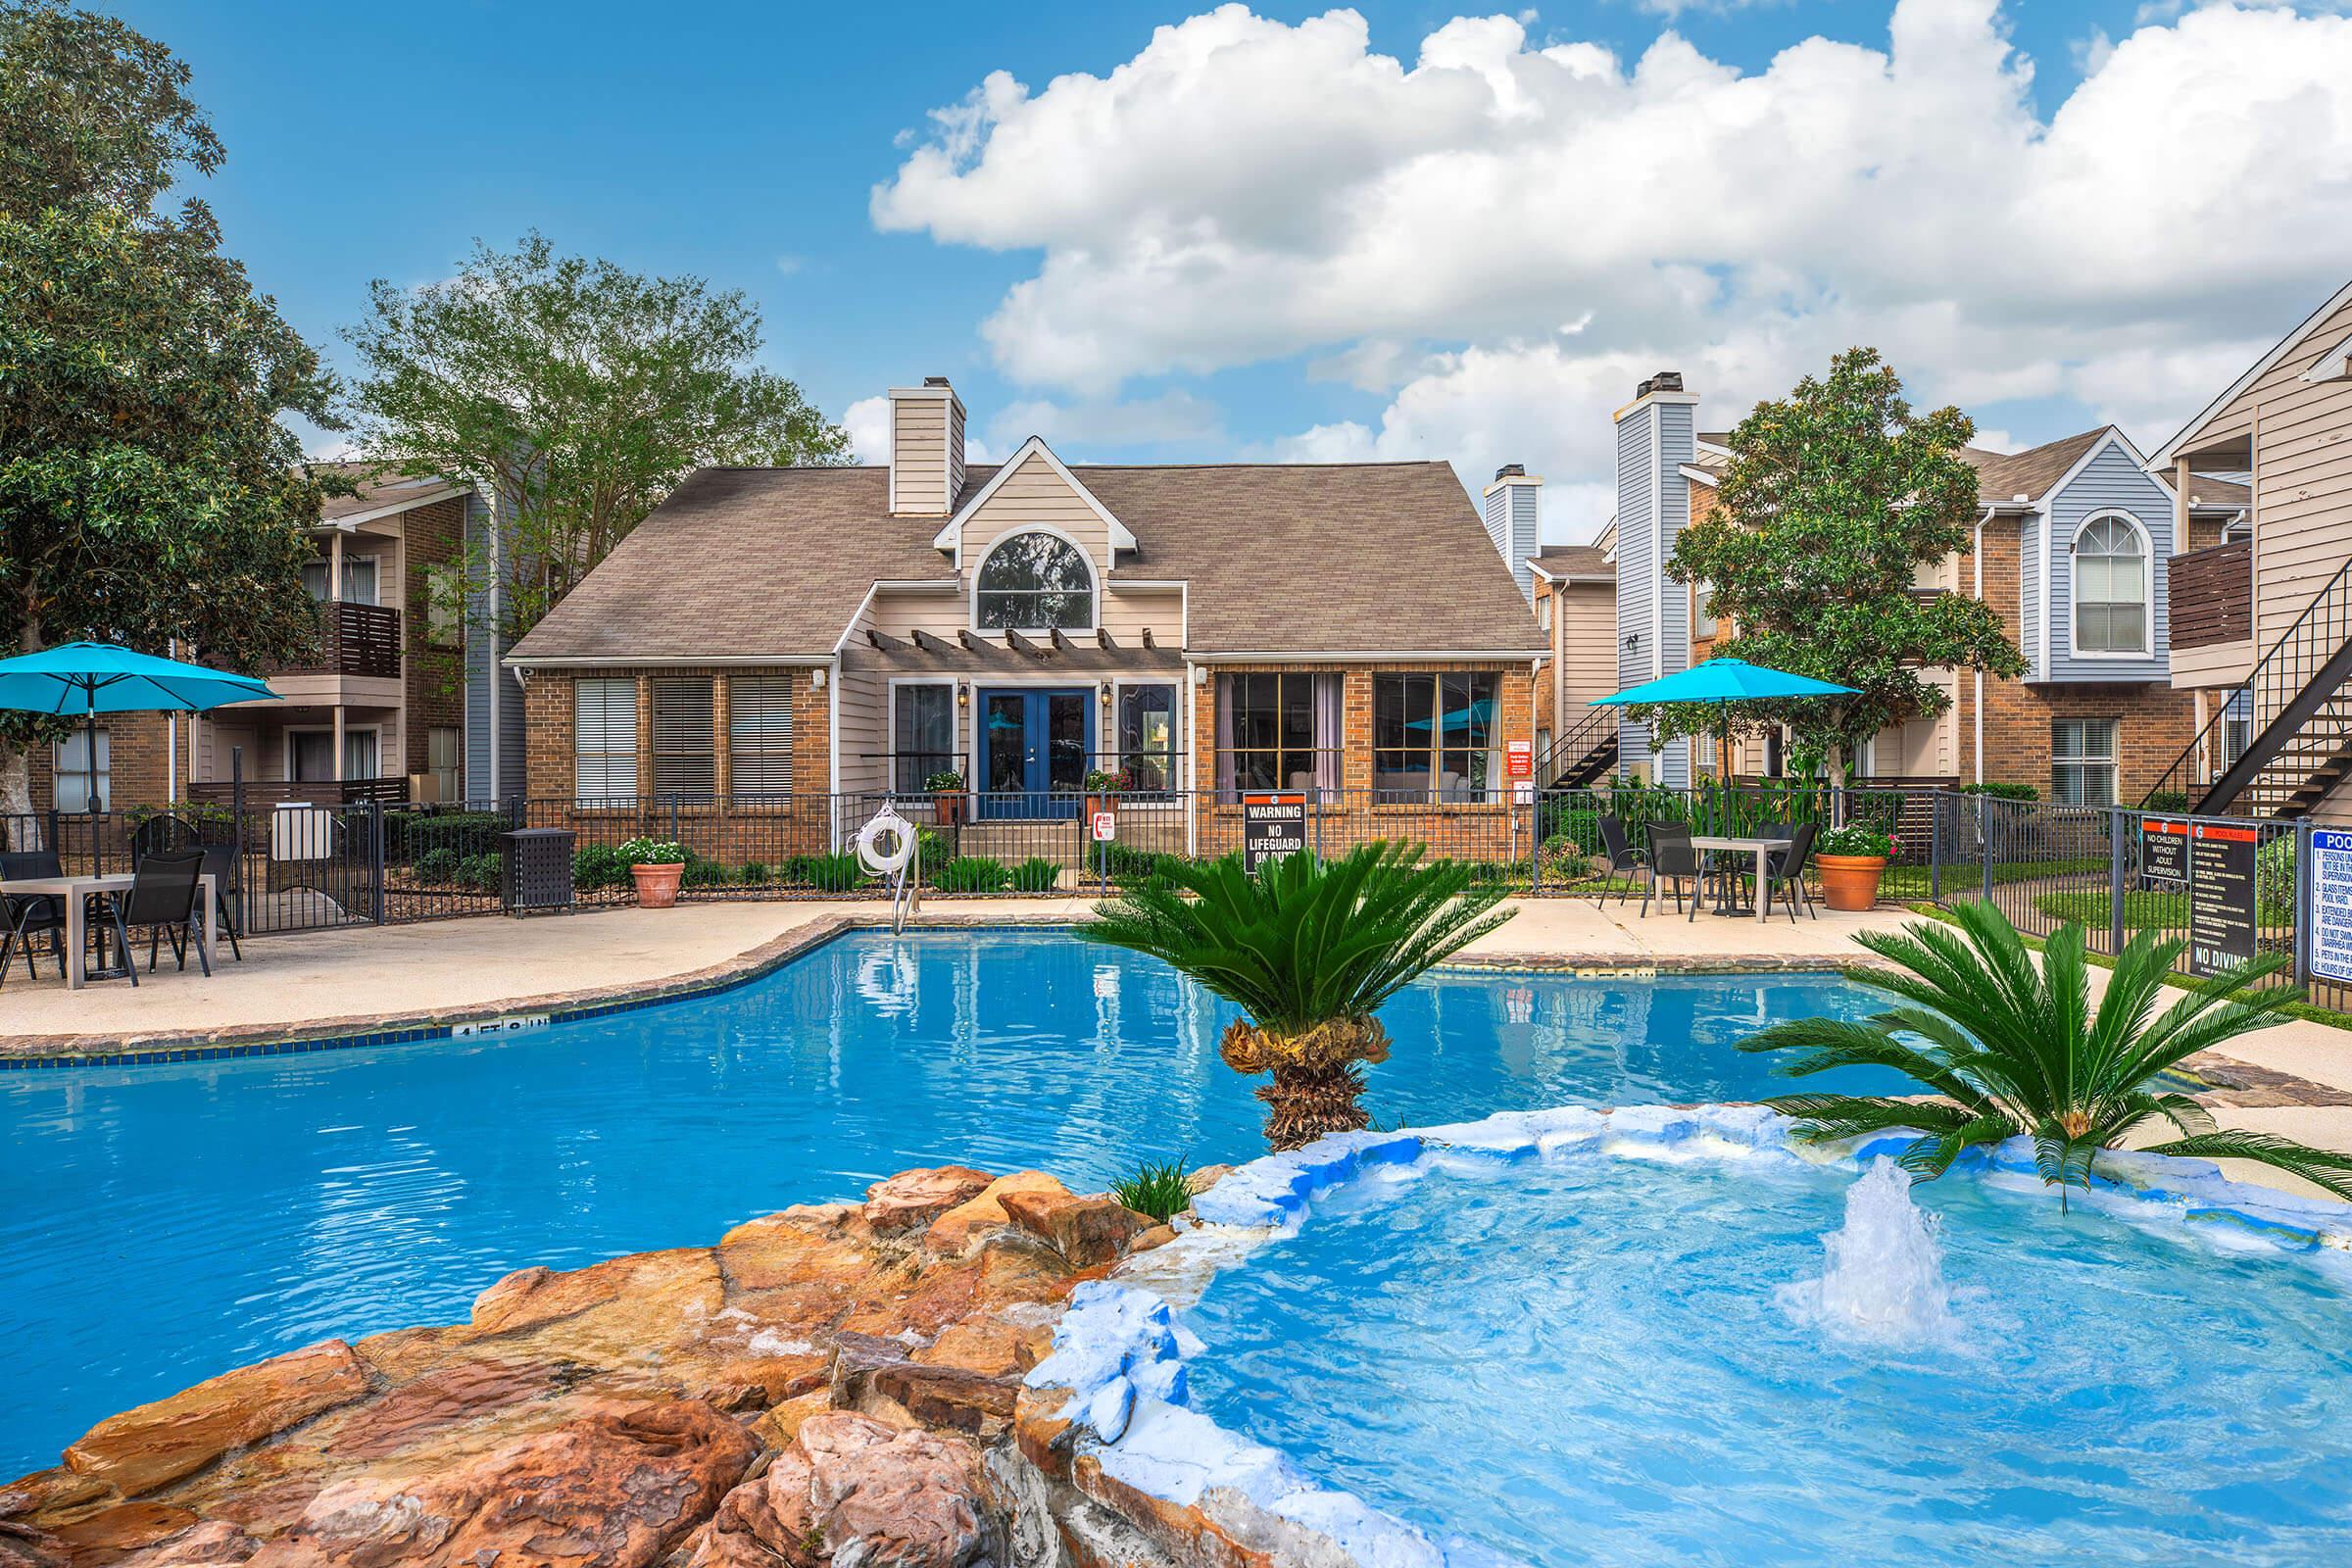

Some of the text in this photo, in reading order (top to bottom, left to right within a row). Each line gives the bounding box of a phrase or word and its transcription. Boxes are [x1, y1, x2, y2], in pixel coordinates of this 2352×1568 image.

[1250, 806, 1301, 818] WARNING
[1268, 825, 1282, 837] NO
[1250, 838, 1301, 850] LIFEGUARD
[2147, 834, 2182, 846] NO CHILDREN
[2327, 834, 2352, 850] POO
[2152, 845, 2178, 856] WITHOUT
[2323, 851, 2345, 862] PERSONS
[2155, 856, 2173, 865] ADULT
[2323, 860, 2332, 870] NOT
[2332, 861, 2339, 871] BE
[2147, 864, 2181, 877] SUPERVISION
[2323, 883, 2337, 894] GLASS
[2322, 893, 2334, 903] POOL
[2322, 905, 2347, 917] EXTENDED
[2322, 915, 2331, 925] ARE
[2322, 927, 2328, 937] DO
[2329, 929, 2339, 939] NOT
[2322, 937, 2345, 951] DIARRHEA
[2195, 946, 2210, 964] NO
[2322, 950, 2333, 960] PETS
[2340, 953, 2349, 963] THE
[2321, 961, 2337, 974] HOURS
[2338, 965, 2345, 975] OF
